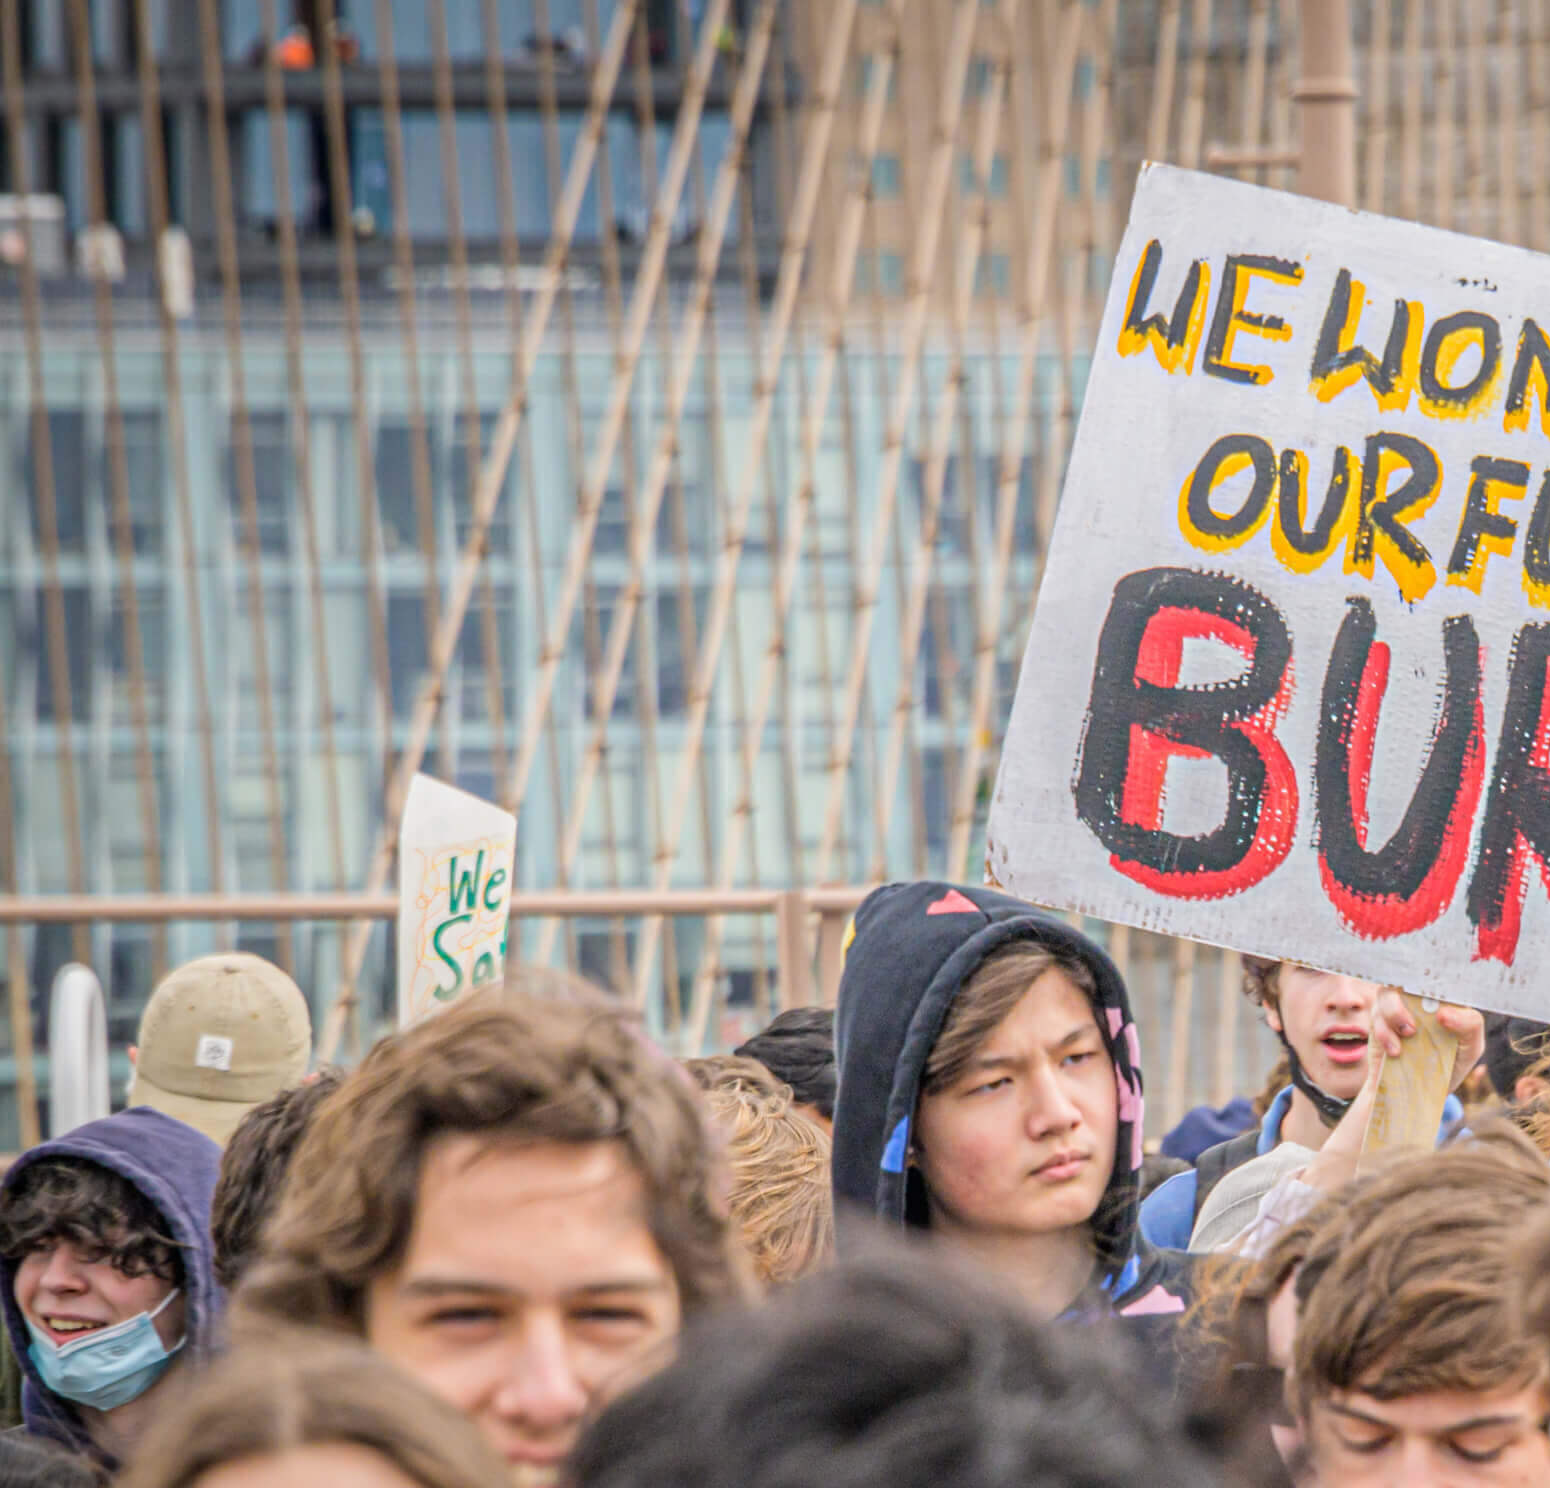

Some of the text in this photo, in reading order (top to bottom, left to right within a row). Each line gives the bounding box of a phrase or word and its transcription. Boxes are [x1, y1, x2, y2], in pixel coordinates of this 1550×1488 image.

[1117, 239, 1304, 386] WE
[1178, 431, 1445, 602] OUR
[449, 849, 507, 915] We
